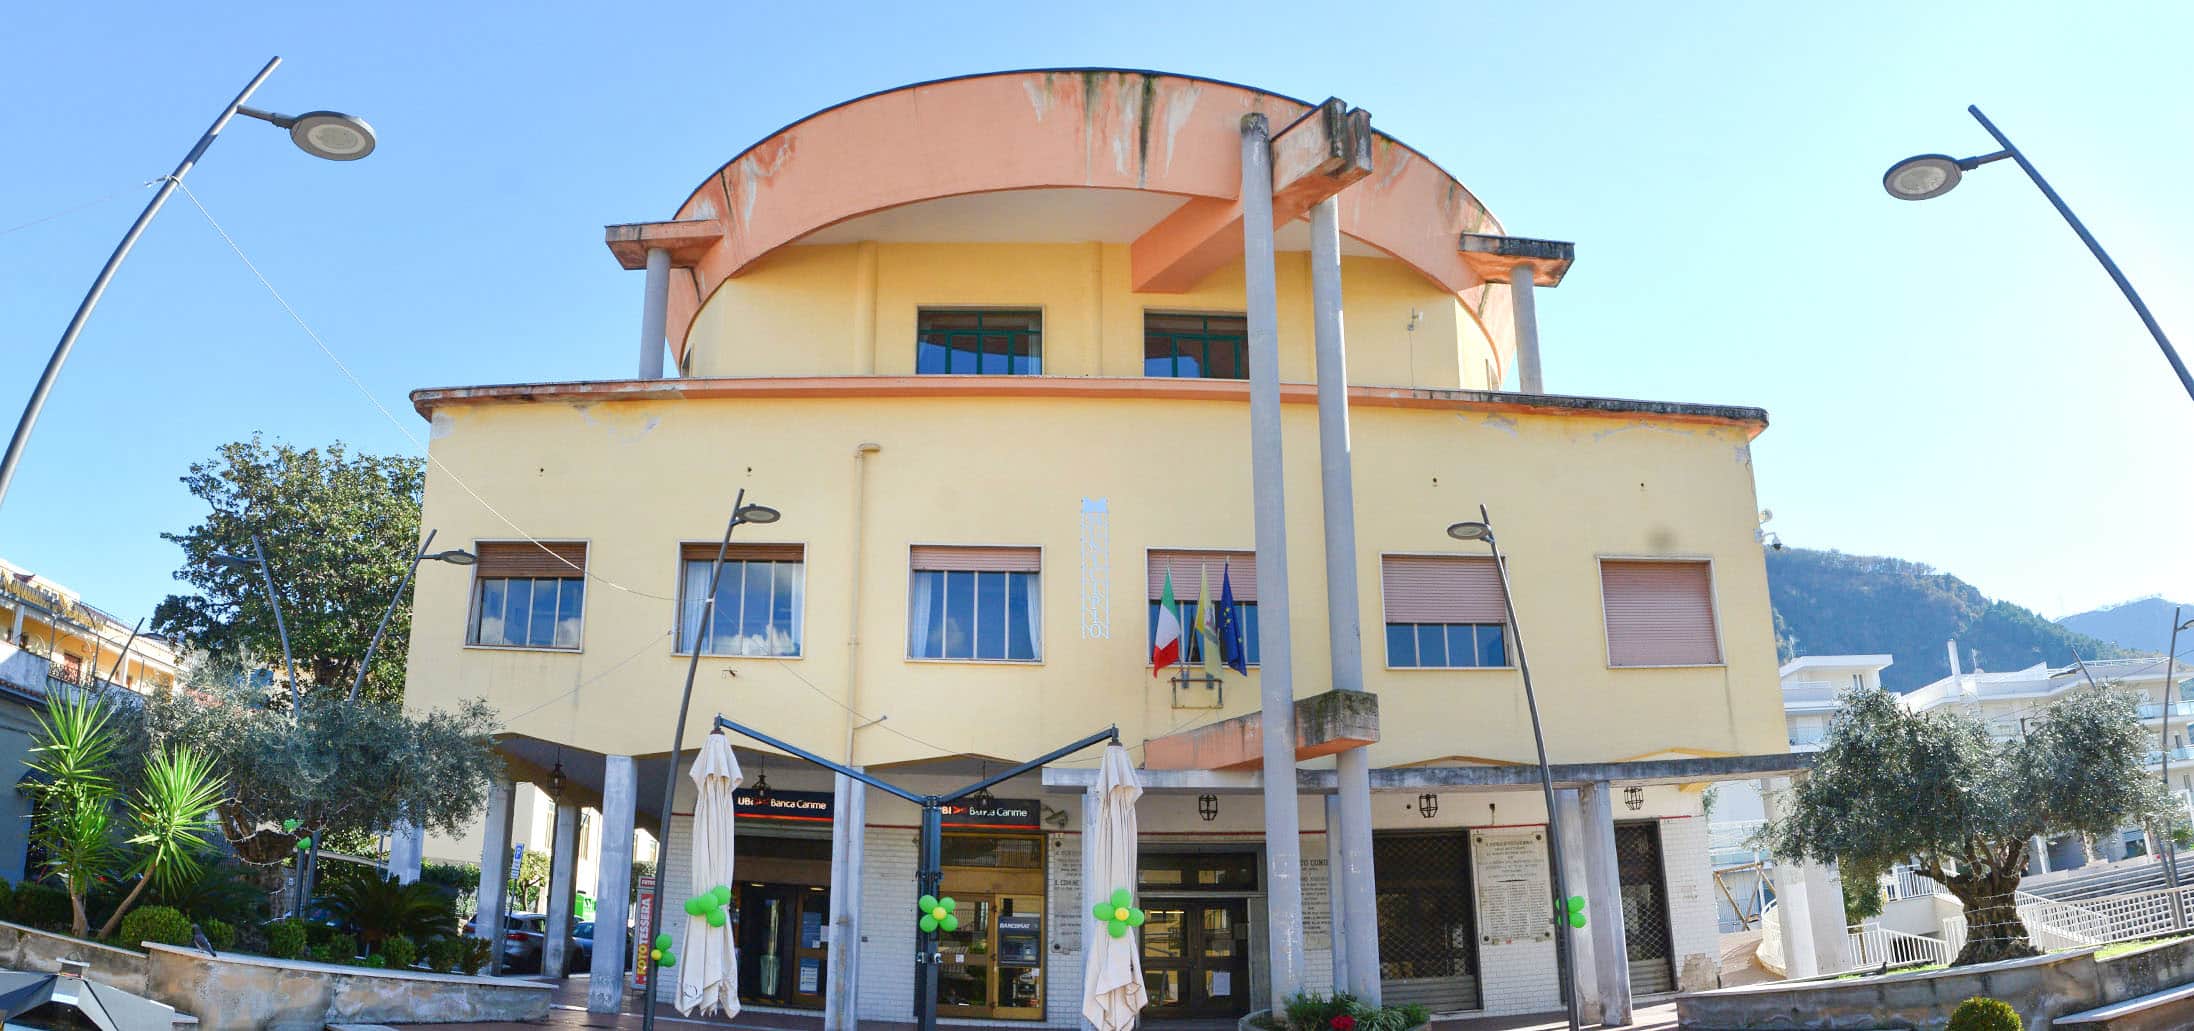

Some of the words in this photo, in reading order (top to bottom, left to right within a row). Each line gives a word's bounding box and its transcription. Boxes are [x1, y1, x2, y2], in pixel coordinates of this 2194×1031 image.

[770, 798, 796, 808] Banca
[796, 800, 827, 810] Carime
[941, 806, 952, 815] BI
[996, 808, 1028, 817] Carime
